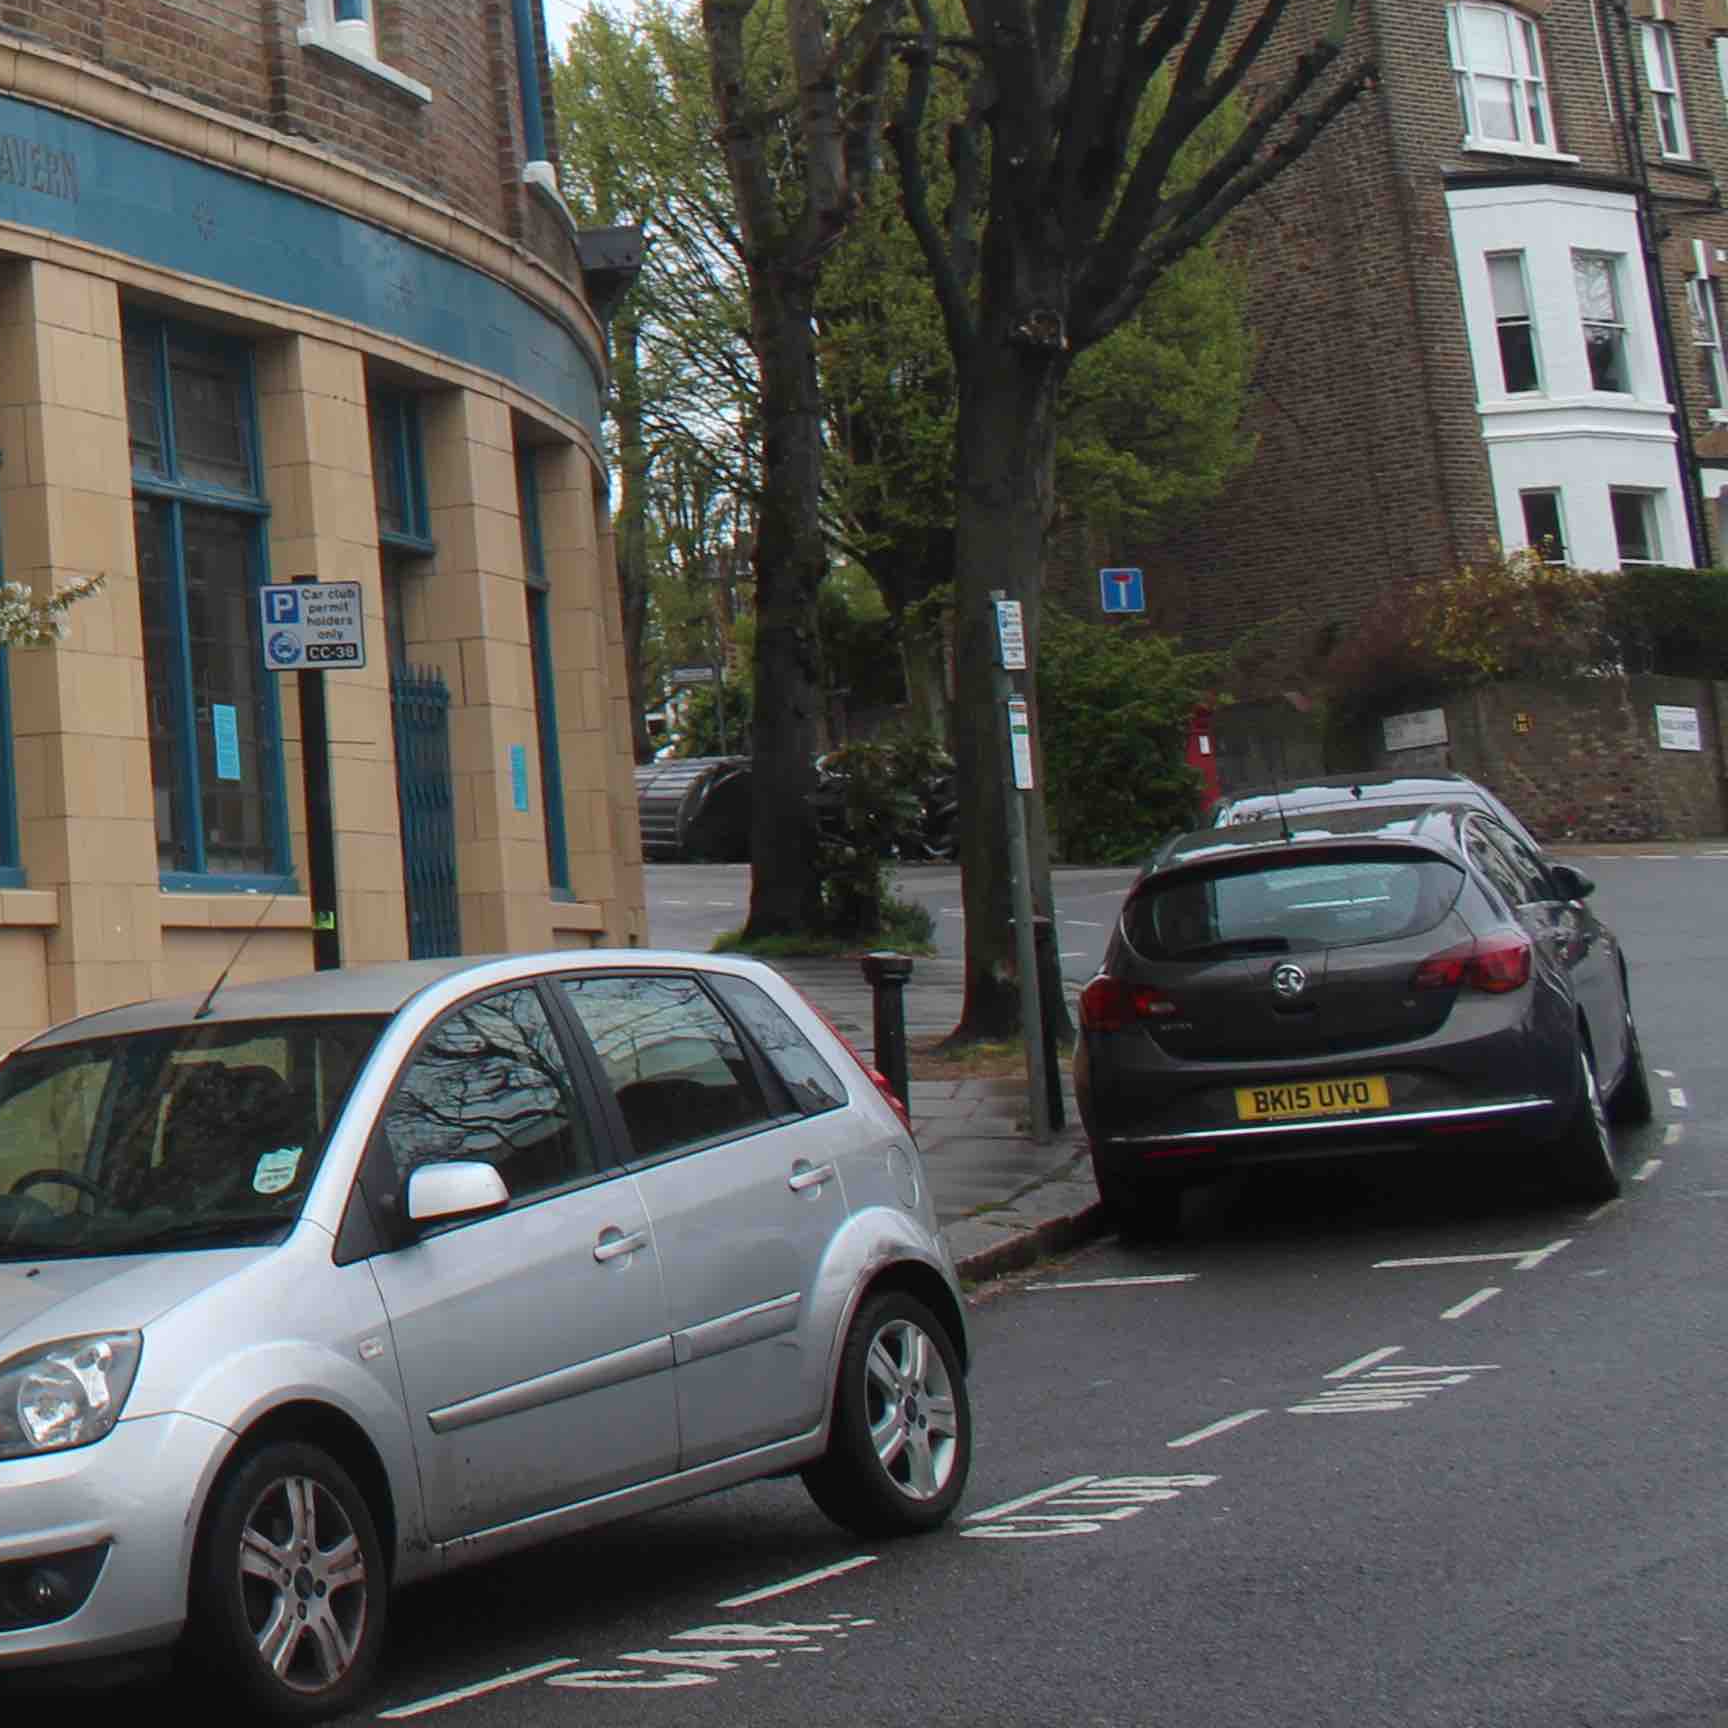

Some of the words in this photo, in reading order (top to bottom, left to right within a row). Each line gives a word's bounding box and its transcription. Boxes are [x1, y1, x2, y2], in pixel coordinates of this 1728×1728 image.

[301, 589, 324, 600] Car
[327, 588, 355, 599] club
[272, 593, 293, 621] P
[308, 602, 349, 614] permit
[306, 616, 353, 626] holders
[317, 629, 344, 640] only
[1253, 1087, 1311, 1113] BK15
[959, 1474, 1222, 1537] CLUB
